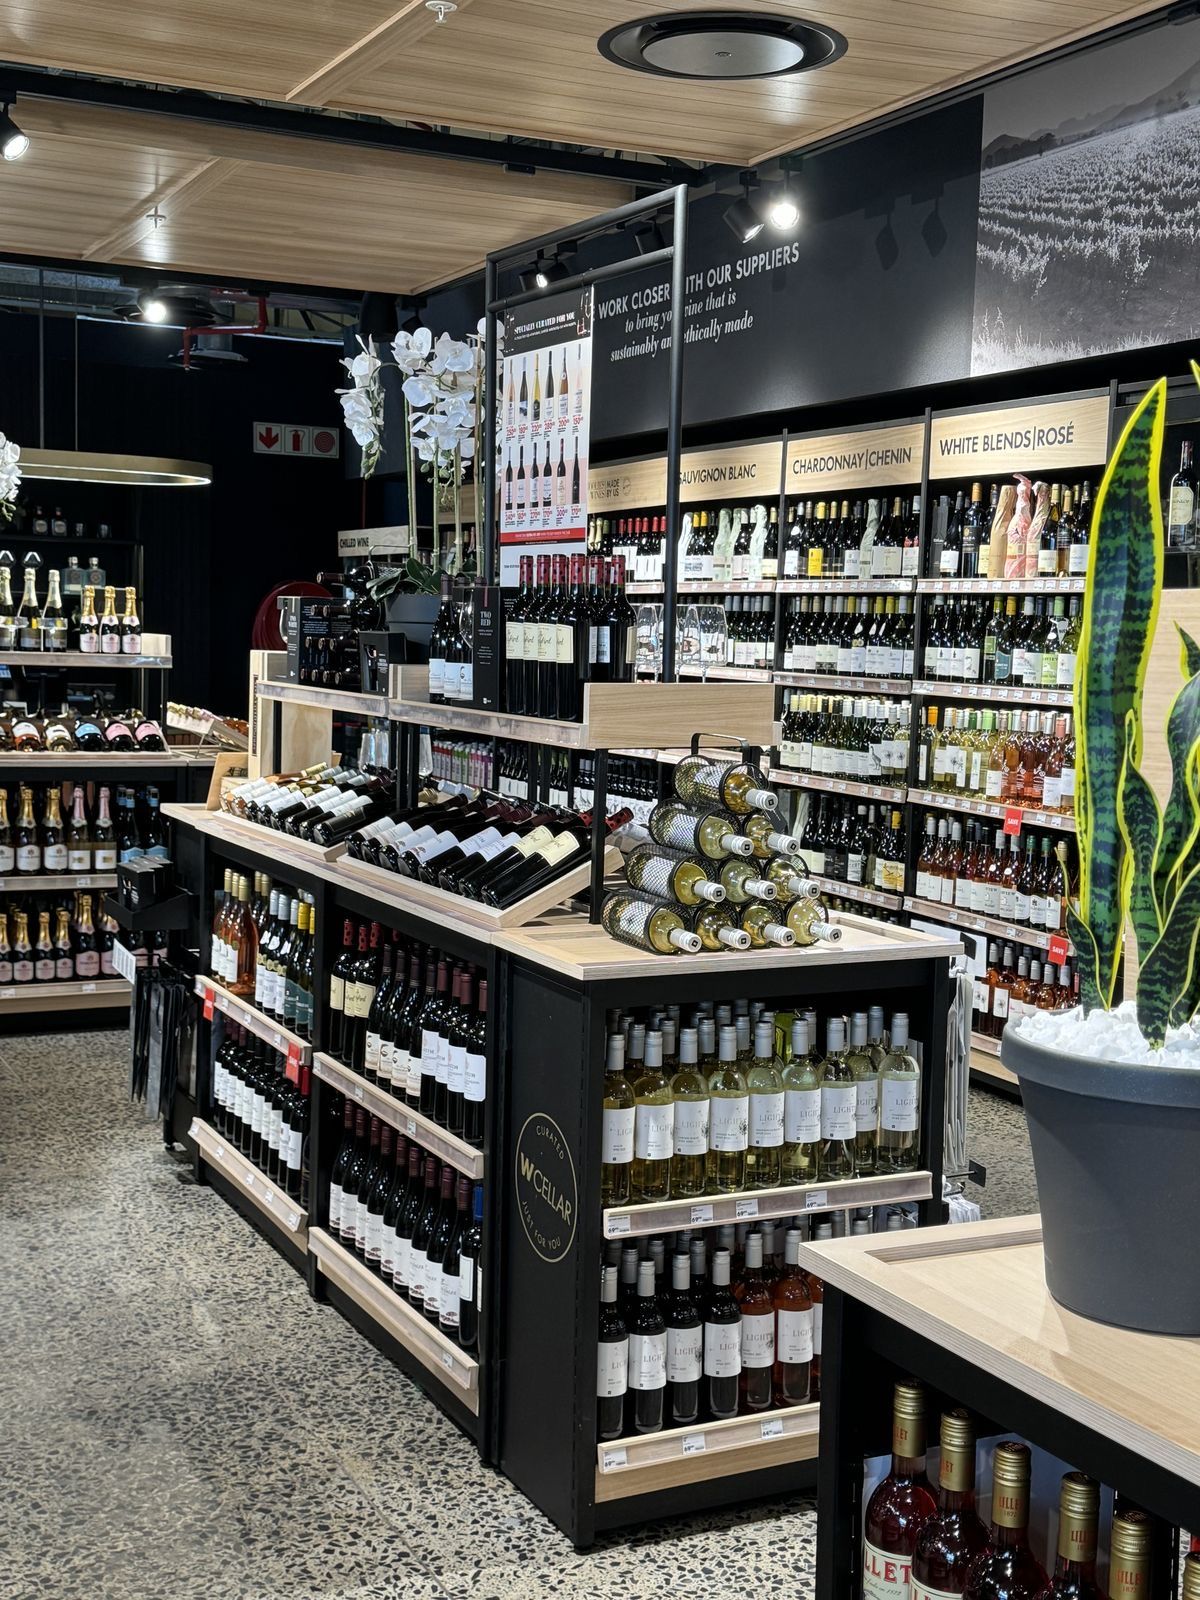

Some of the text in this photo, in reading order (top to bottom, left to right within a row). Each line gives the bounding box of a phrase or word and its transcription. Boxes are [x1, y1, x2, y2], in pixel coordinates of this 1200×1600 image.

[598, 295, 629, 320] WORK
[631, 283, 670, 310] CLOSER
[685, 274, 704, 294] ITH
[706, 264, 732, 288] OUR
[735, 242, 800, 280] SUPPLIERS
[625, 315, 634, 333] to
[635, 312, 659, 332] bring
[661, 311, 673, 330] yo
[705, 292, 726, 312] that
[727, 288, 737, 306] is
[610, 335, 660, 362] sustainably
[660, 335, 673, 350] an
[724, 311, 754, 335] made
[939, 436, 979, 457] WHITE
[728, 463, 757, 480] BLANC
[1007, 818, 1020, 826] SAVE
[1052, 945, 1065, 956] SAVE
[536, 1125, 565, 1160] CURATED
[522, 1200, 562, 1250] JUST FOR YOU
